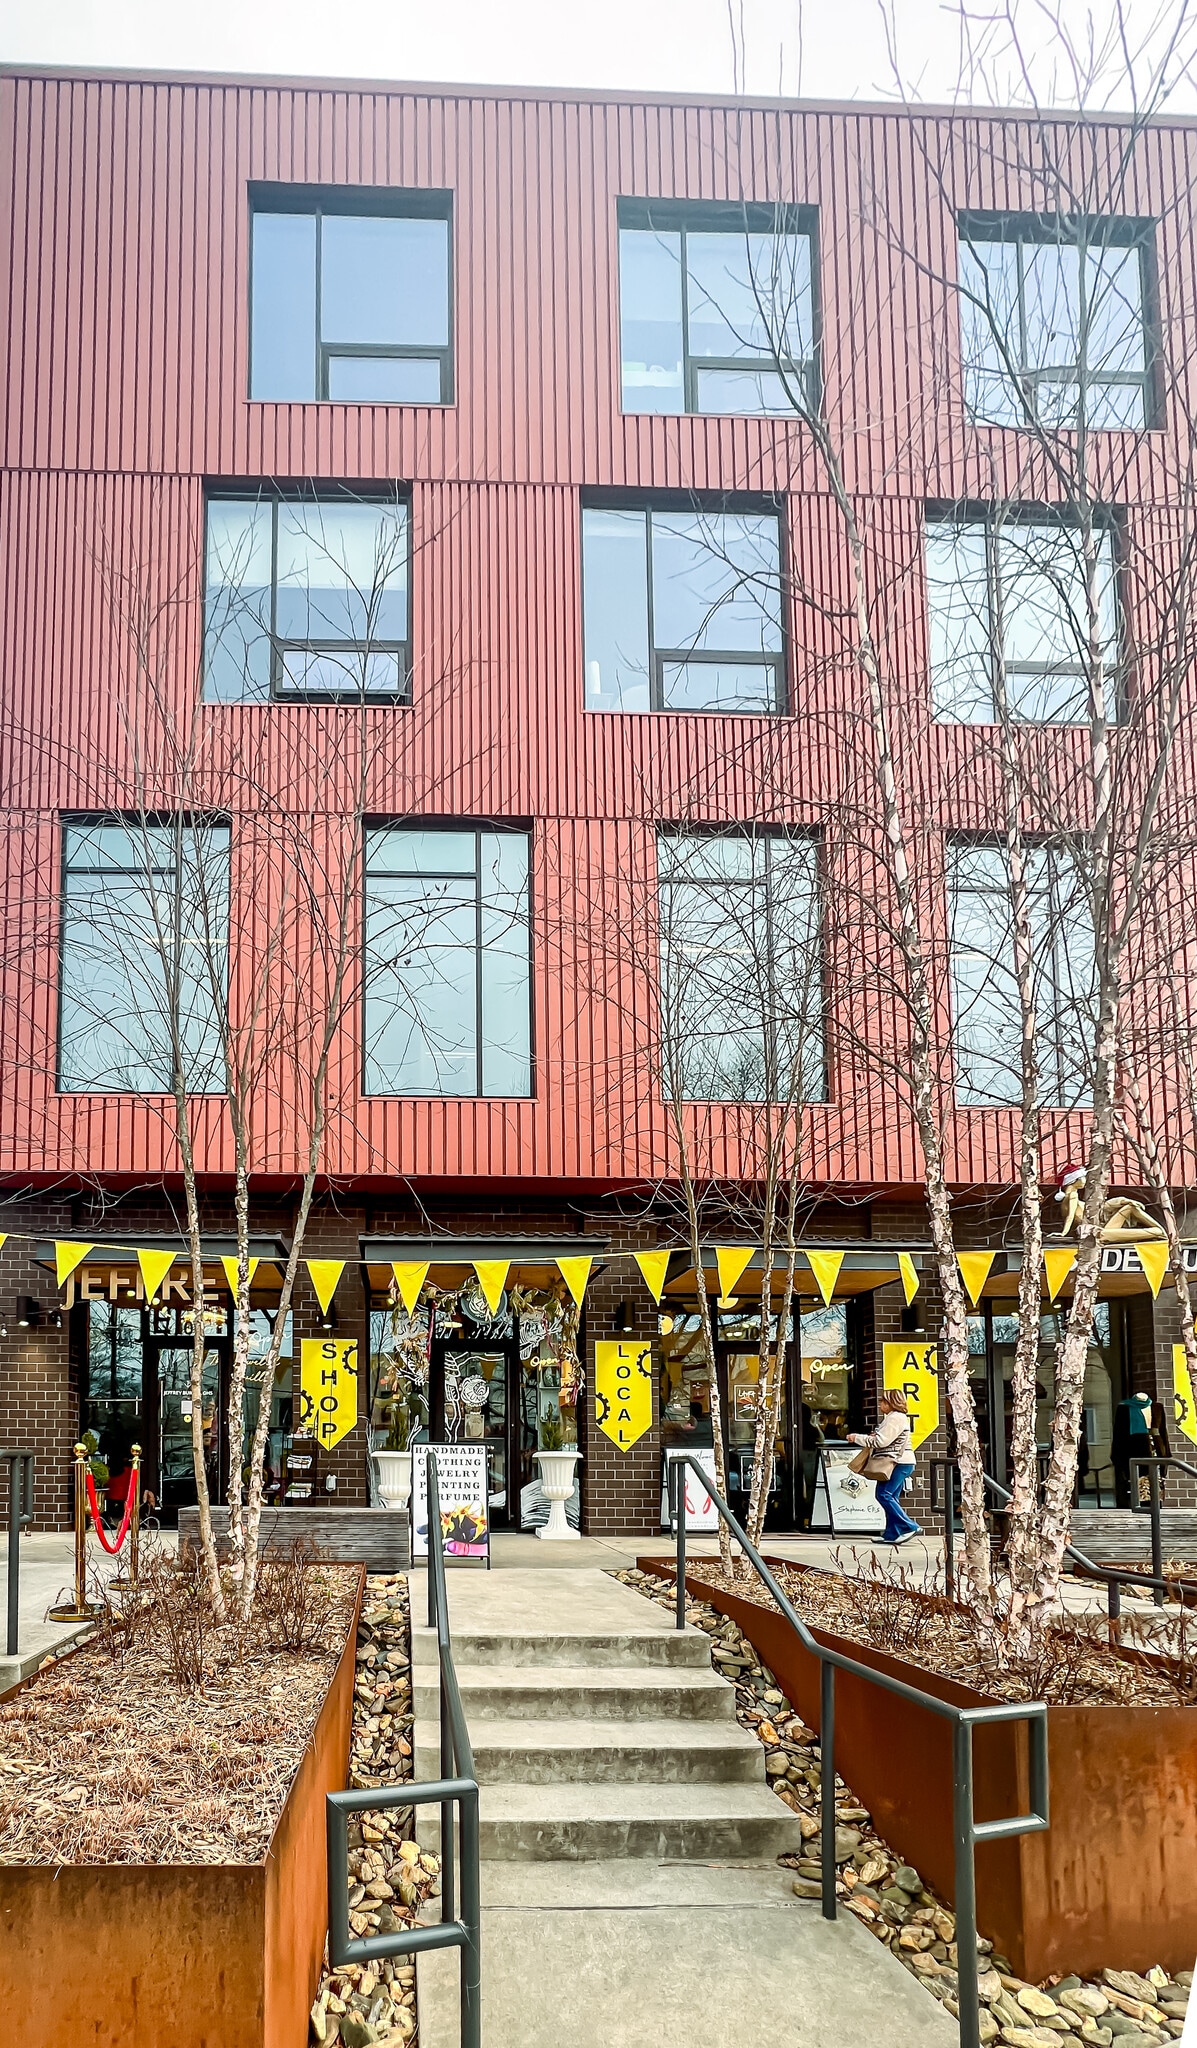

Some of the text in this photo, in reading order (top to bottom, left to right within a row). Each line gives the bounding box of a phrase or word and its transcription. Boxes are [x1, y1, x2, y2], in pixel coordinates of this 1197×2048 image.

[530, 1356, 558, 1371] Open
[810, 1359, 854, 1380] Open
[321, 1343, 338, 1438] SHOP
[616, 1345, 631, 1442] LOCAL
[902, 1351, 920, 1433] ART
[417, 1458, 481, 1466] COTHING
[420, 1470, 479, 1478] JWELRY
[420, 1493, 480, 1501] PRFUME
